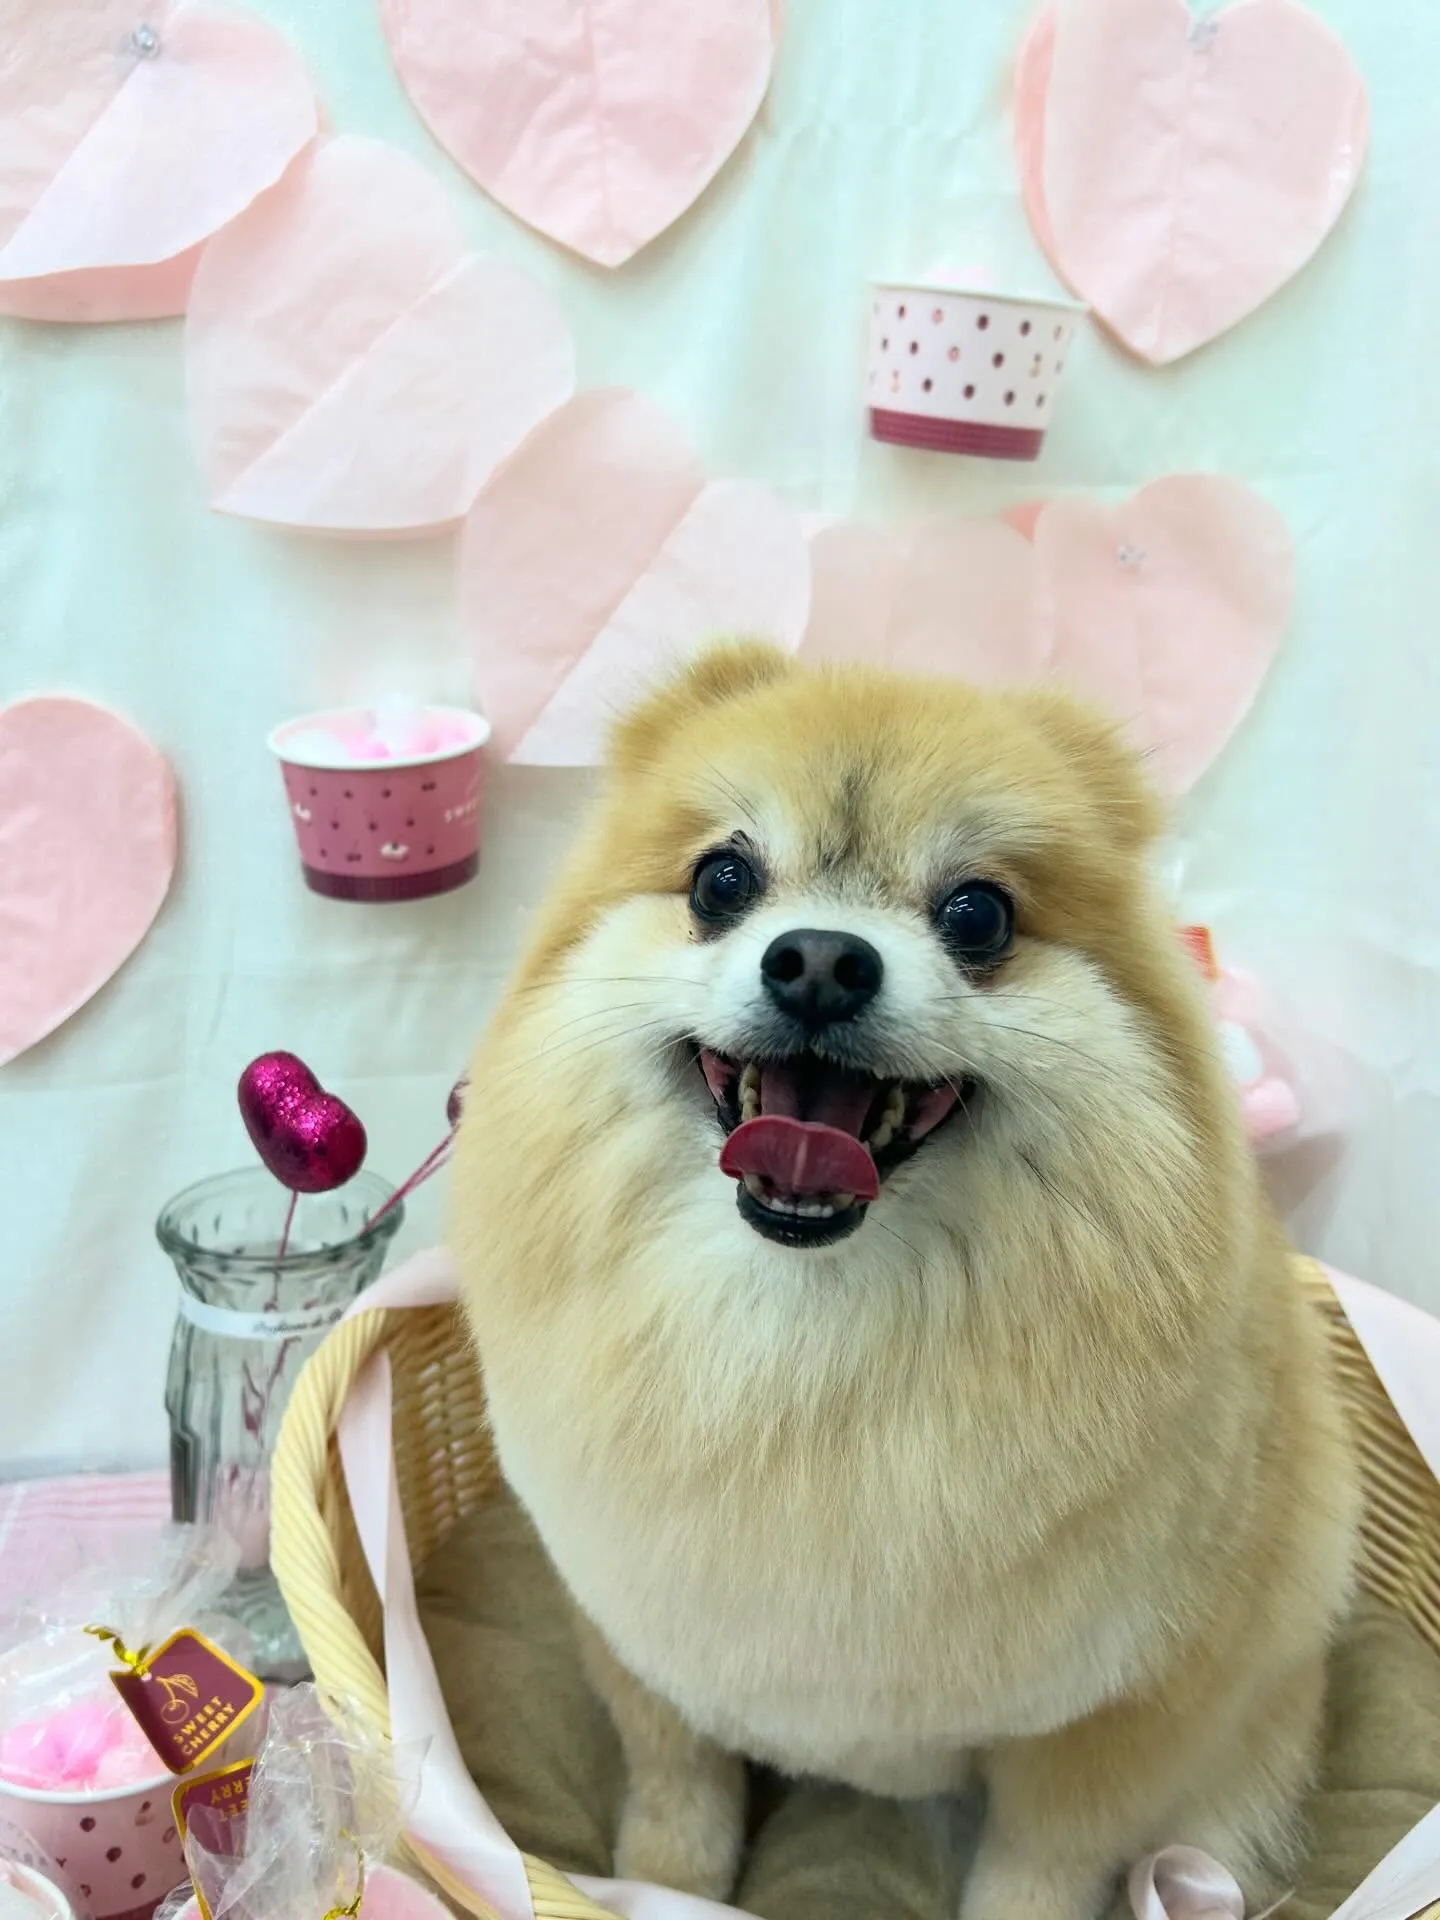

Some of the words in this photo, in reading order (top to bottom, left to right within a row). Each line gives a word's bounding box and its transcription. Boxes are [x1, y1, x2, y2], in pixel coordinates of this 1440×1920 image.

[173, 1696, 221, 1744] SWEET
[182, 1703, 235, 1756] CHERRY
[218, 1799, 248, 1822] EET
